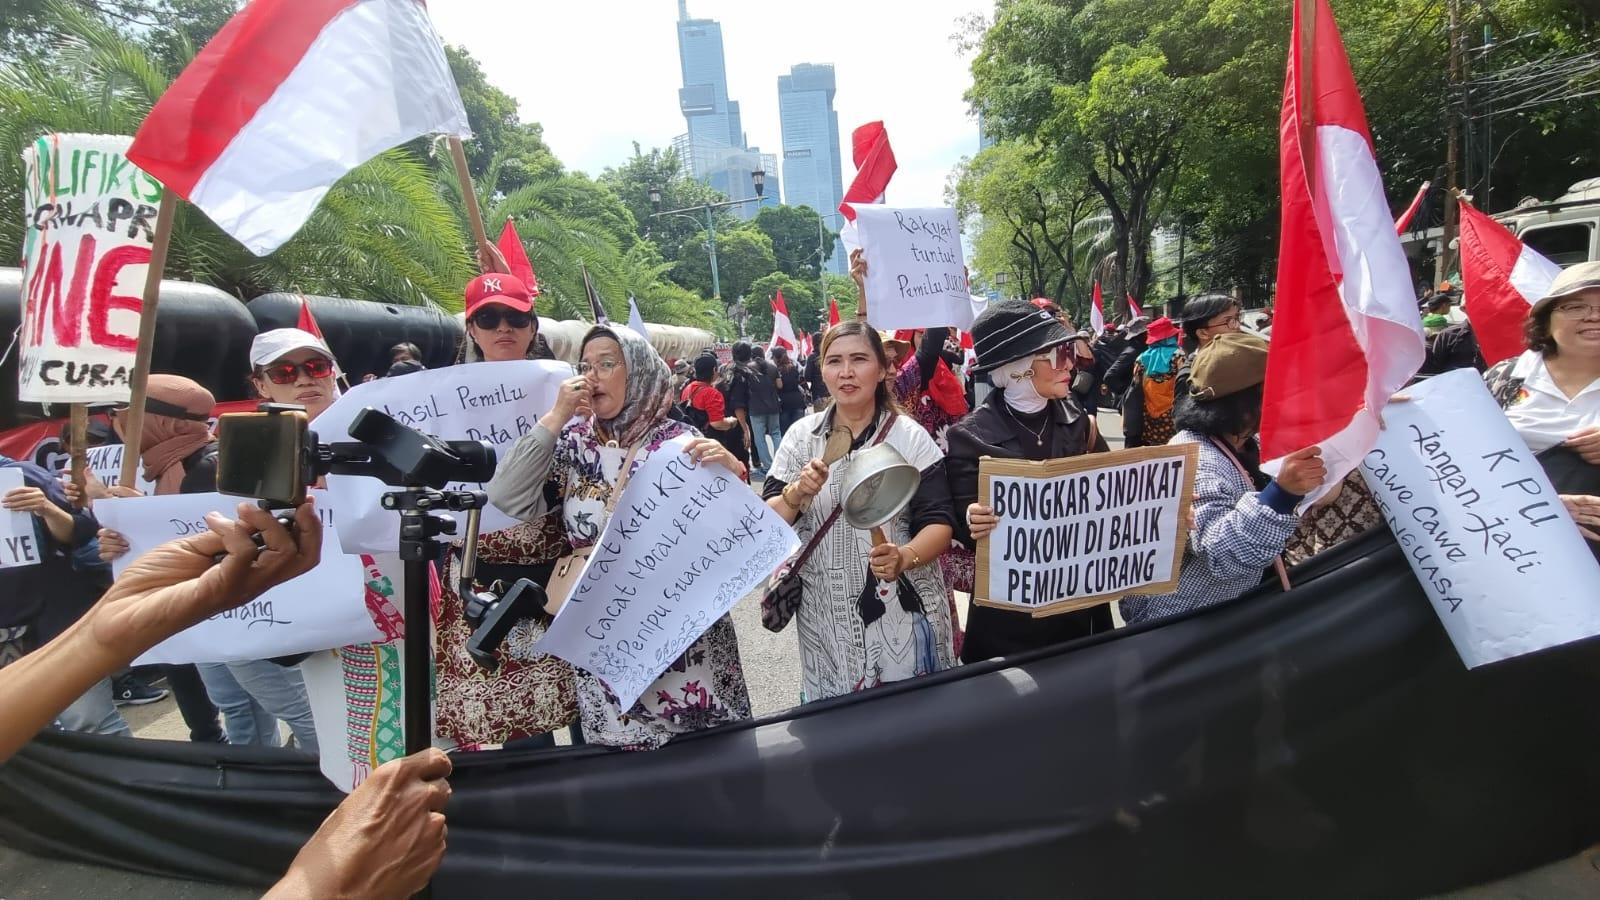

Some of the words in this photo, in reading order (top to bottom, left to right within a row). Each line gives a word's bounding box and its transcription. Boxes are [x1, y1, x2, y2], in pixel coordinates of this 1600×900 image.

[894, 211, 953, 242] Rakyat
[911, 243, 956, 264] tuntut
[484, 278, 502, 293] NY
[39, 360, 134, 389] CURA
[993, 476, 1090, 520] BONGKAR
[1096, 460, 1183, 512] SINDIKAT
[585, 585, 636, 640] Cacat
[672, 518, 688, 536] &
[681, 476, 731, 521] Etika
[1003, 522, 1080, 564] JOKOWI
[1084, 518, 1105, 555] DI
[1108, 506, 1163, 550] BALIK
[617, 605, 672, 658] Penipu
[706, 503, 765, 557] Rakyat
[1007, 564, 1080, 605] PEMILU
[1084, 549, 1157, 594] CURANG
